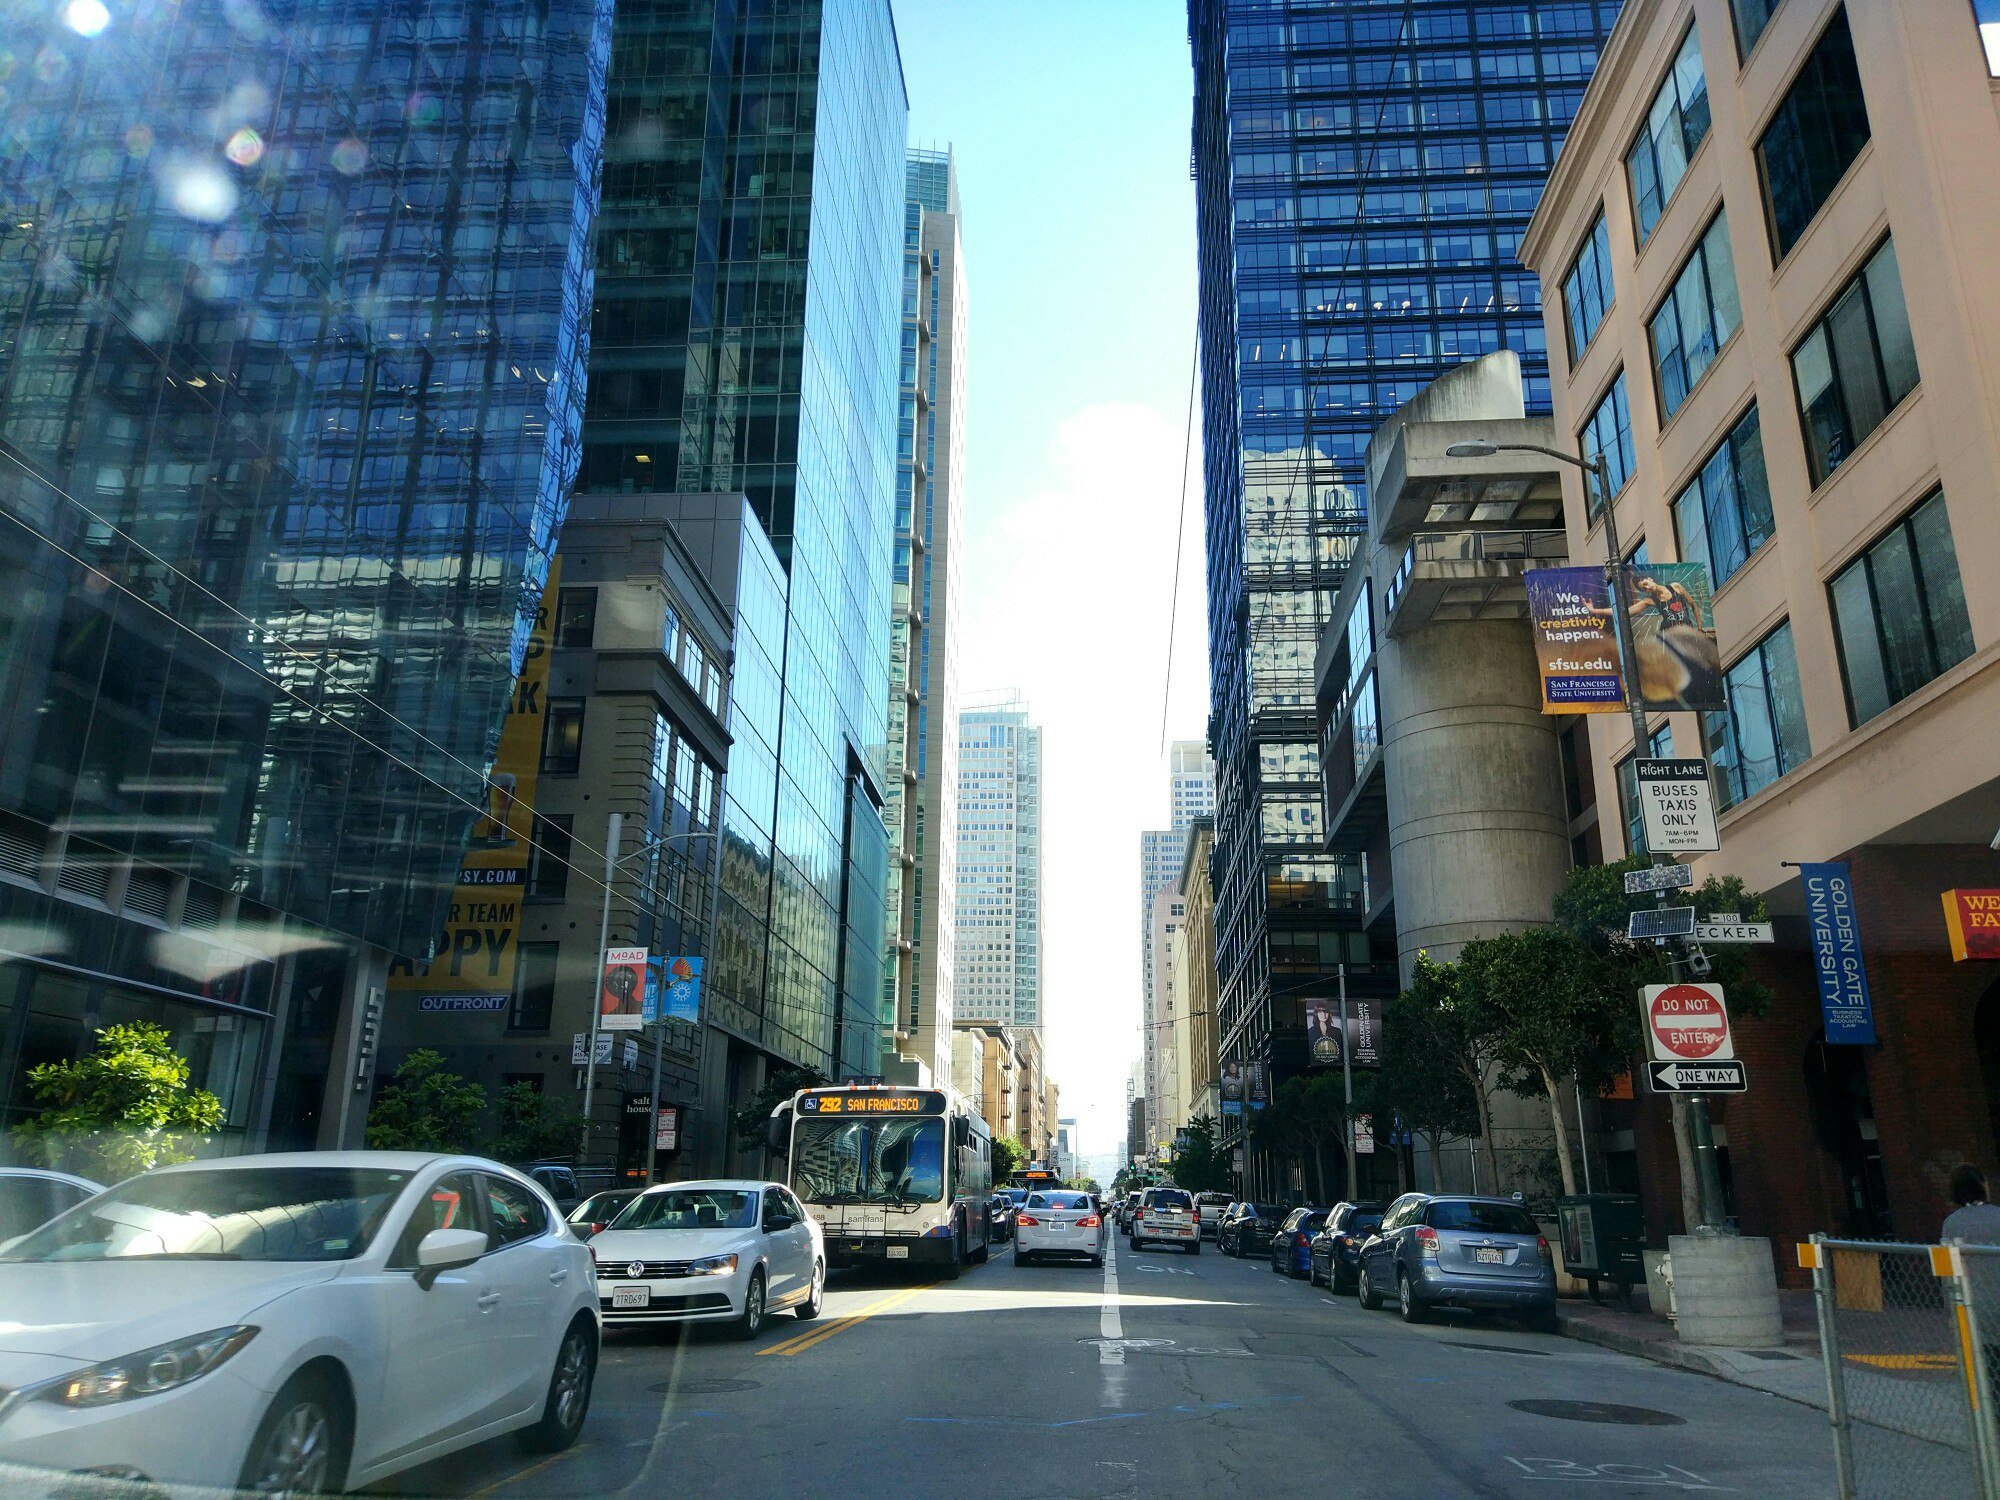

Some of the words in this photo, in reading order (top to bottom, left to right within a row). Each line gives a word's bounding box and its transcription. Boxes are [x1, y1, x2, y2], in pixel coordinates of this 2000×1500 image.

[1556, 592, 1580, 603] We
[1552, 604, 1589, 616] make
[1540, 616, 1606, 629] creativity
[1546, 630, 1604, 642] happen.
[1549, 658, 1612, 670] sfsu.edu
[1570, 680, 1615, 688] FRANCISCO
[1640, 765, 1670, 776] RIGHT
[1674, 766, 1703, 775] LANE
[1652, 785, 1698, 796] BUSES
[1658, 799, 1697, 811] TAXIS
[1662, 814, 1697, 826] ONLY
[459, 870, 517, 883] SY.COM
[467, 903, 515, 923] TEAM
[1722, 914, 1738, 922] 100
[1969, 912, 2000, 927] FA
[1696, 927, 1759, 938] ECKER
[1808, 877, 1842, 1004] UNIVERSITY
[1829, 878, 1855, 952] GOLDEN
[1842, 958, 1864, 1006] GATE
[421, 997, 504, 1009] OUTFRONT
[1661, 1000, 1679, 1010] DO
[1684, 999, 1710, 1010] NOT
[1364, 1002, 1372, 1048] UNIVERSITY
[1670, 1032, 1710, 1044] ENTER
[1676, 1070, 1702, 1082] ONE
[1705, 1070, 1733, 1082] WAY
[632, 1096, 650, 1105] salt
[820, 1097, 842, 1112] 292
[848, 1098, 866, 1110] SAN
[868, 1098, 919, 1110] FRANCISCO
[848, 1215, 884, 1223] samTrans
[616, 1294, 647, 1304] 7TRD697
